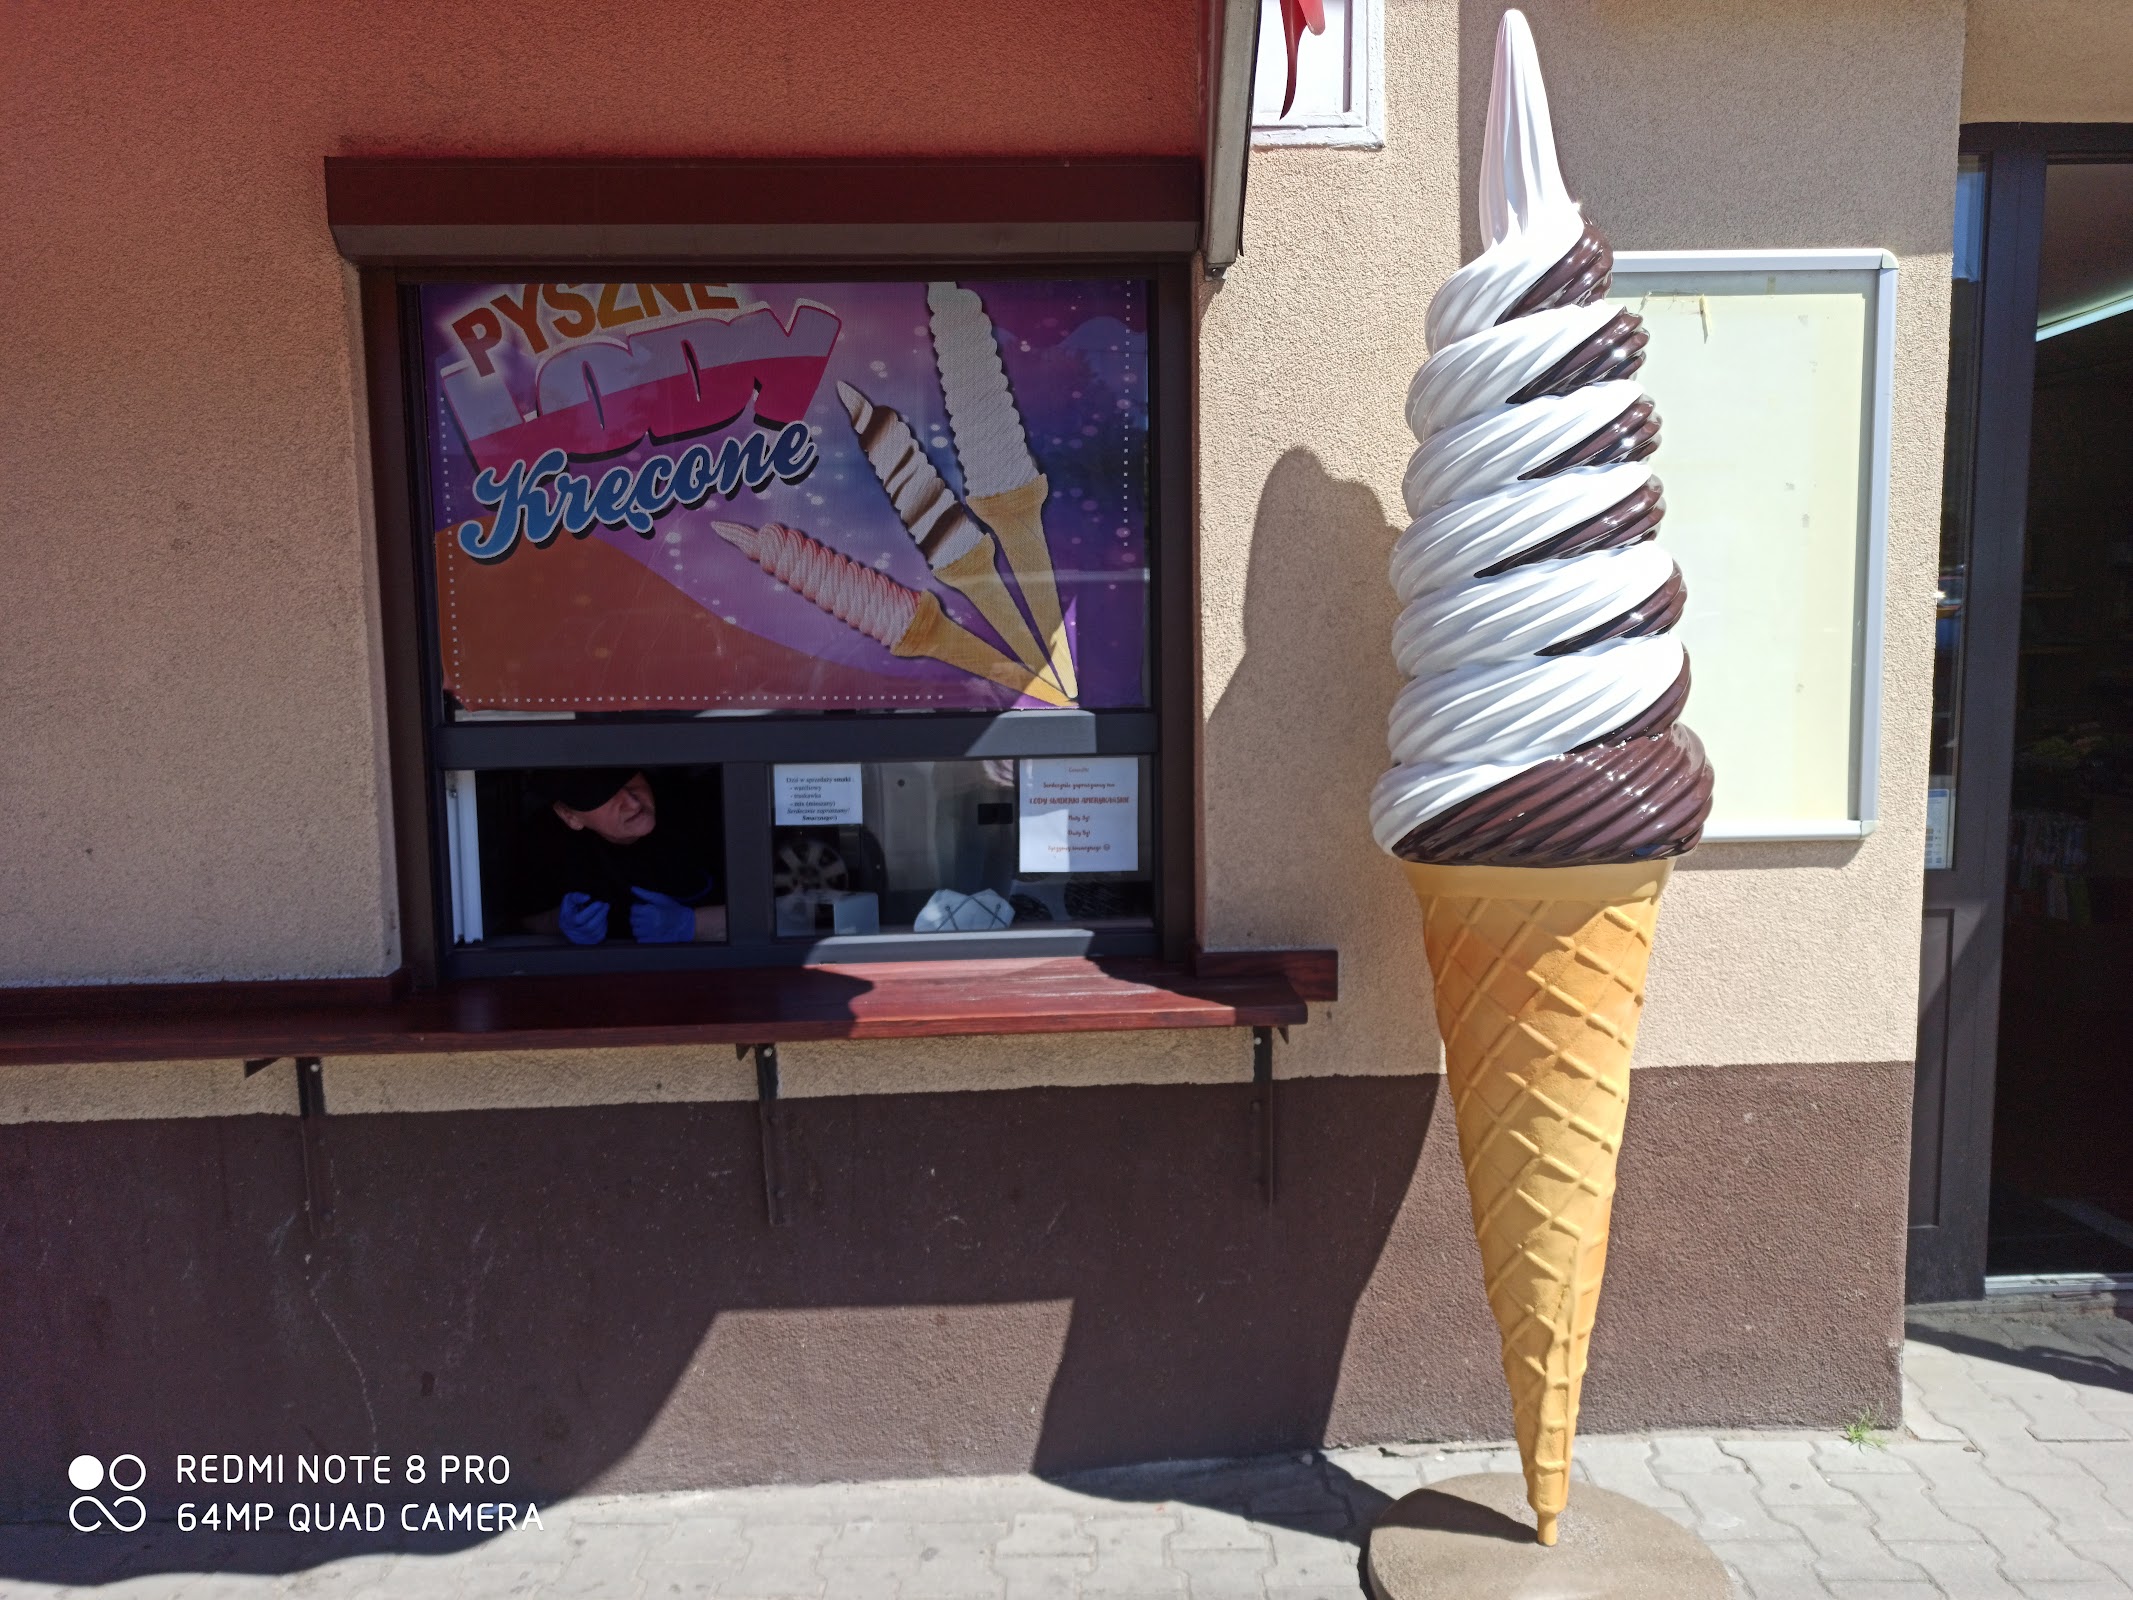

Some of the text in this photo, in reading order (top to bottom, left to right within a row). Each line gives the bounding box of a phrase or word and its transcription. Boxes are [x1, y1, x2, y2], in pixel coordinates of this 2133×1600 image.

[441, 299, 842, 482] LODY
[452, 283, 740, 377] PYSZNE
[458, 420, 819, 560] Kręcone
